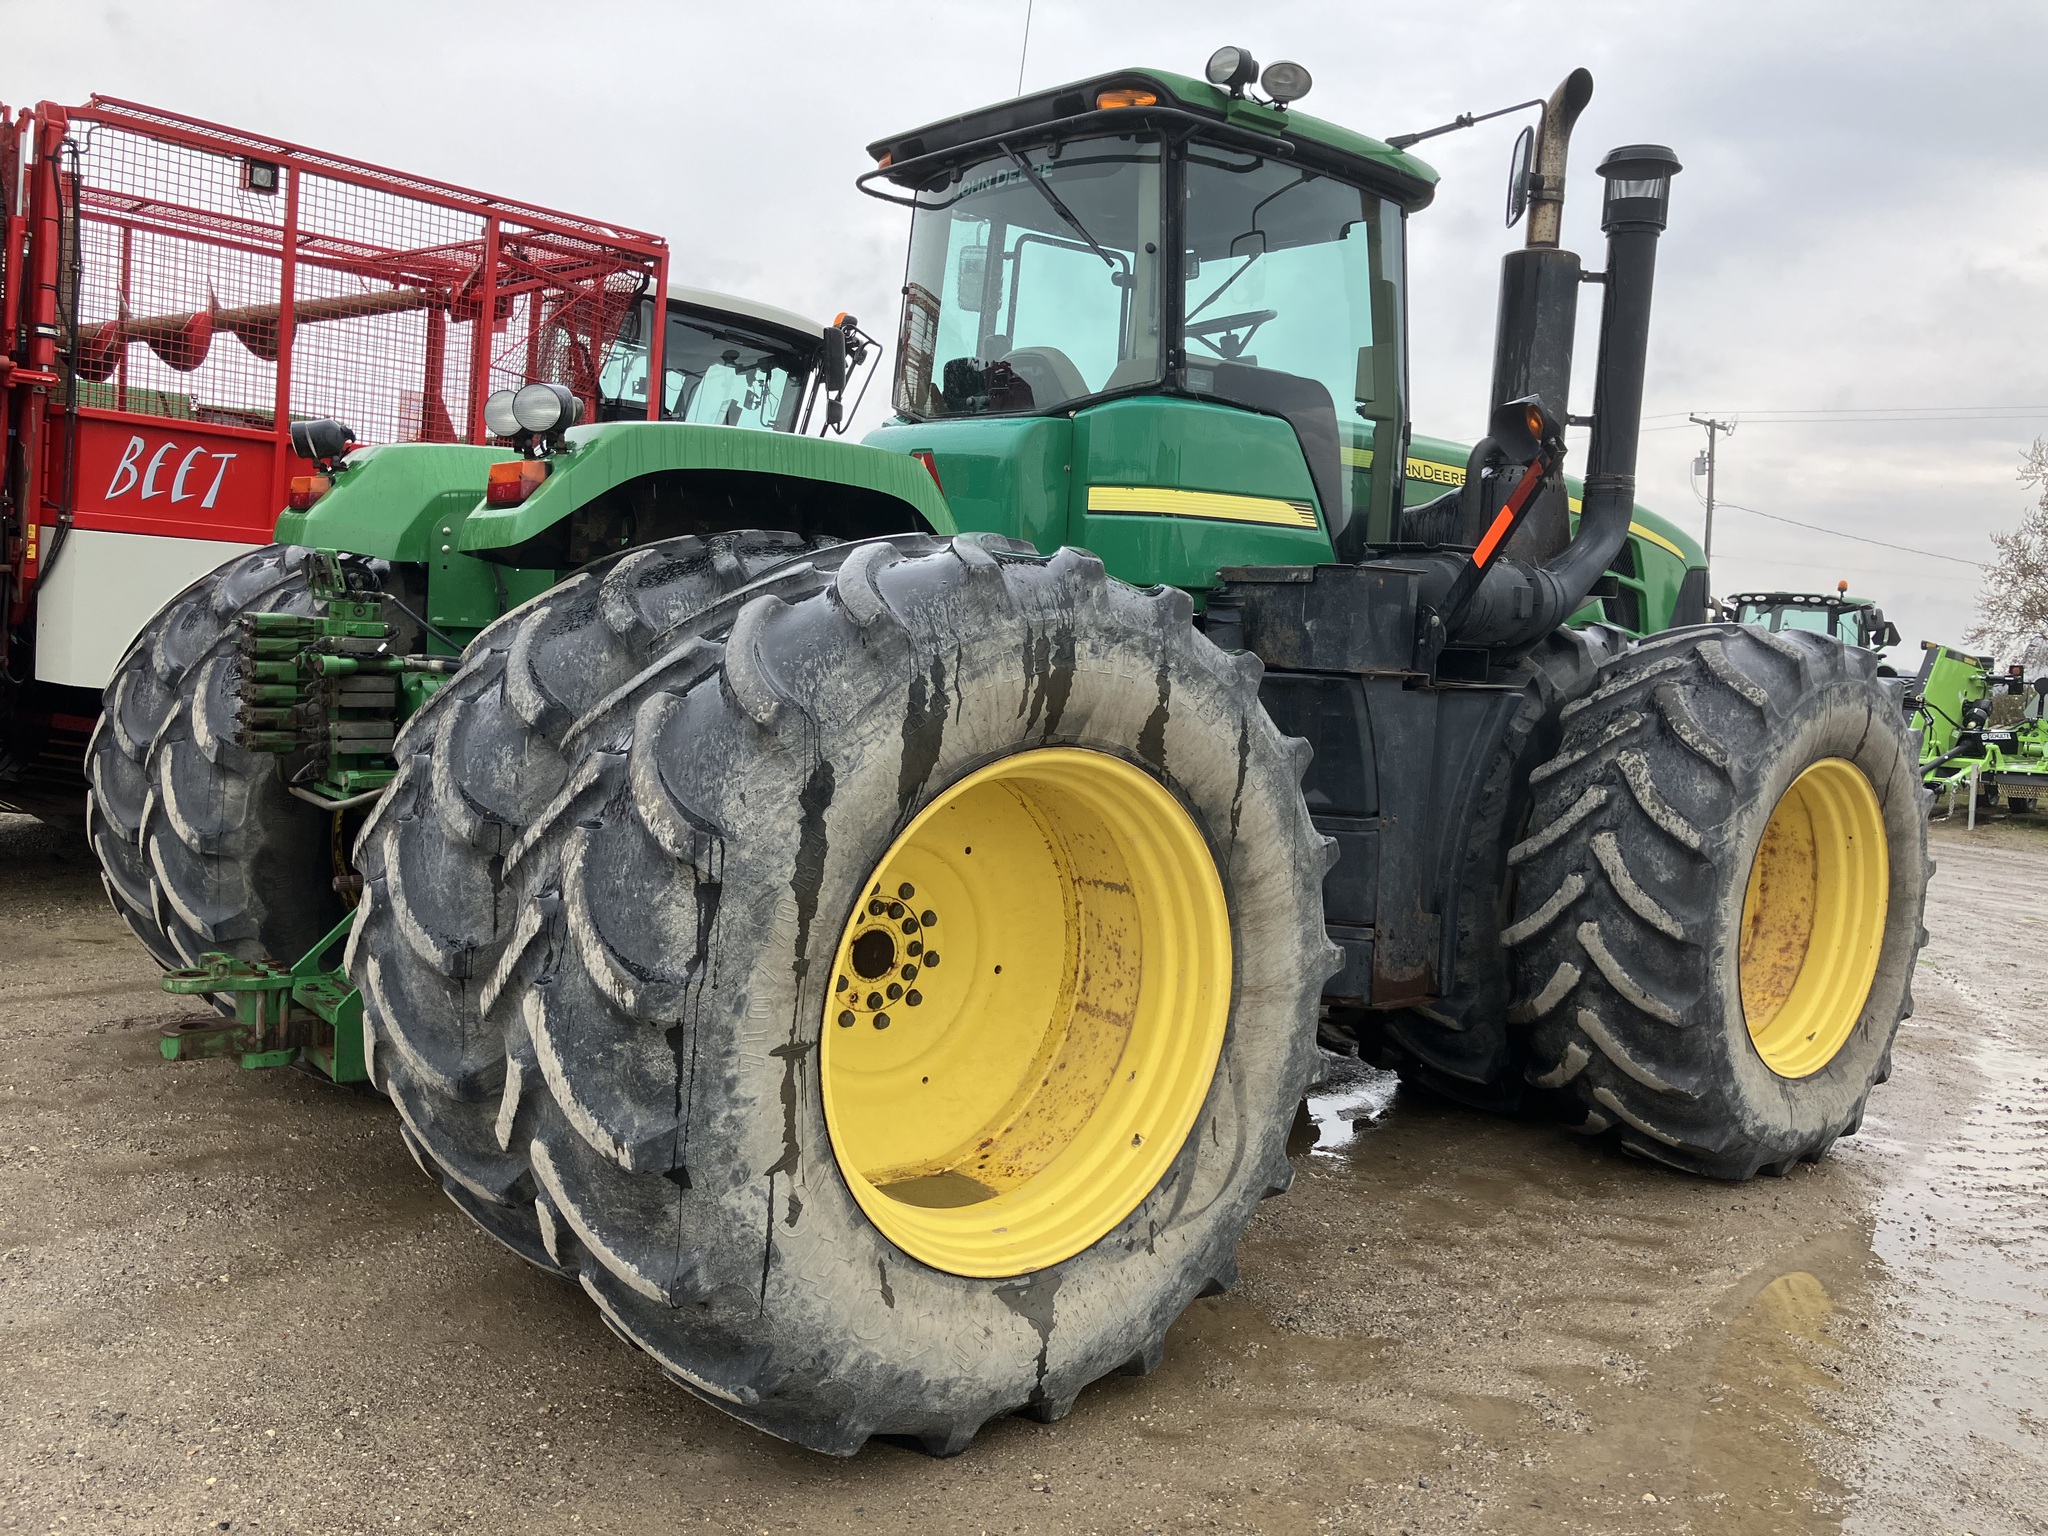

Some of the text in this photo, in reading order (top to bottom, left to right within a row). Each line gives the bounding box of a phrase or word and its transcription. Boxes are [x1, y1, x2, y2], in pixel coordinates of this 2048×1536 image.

[952, 175, 992, 199] JOHN
[104, 435, 238, 509] BEET
[1423, 465, 1466, 484] DEERE
